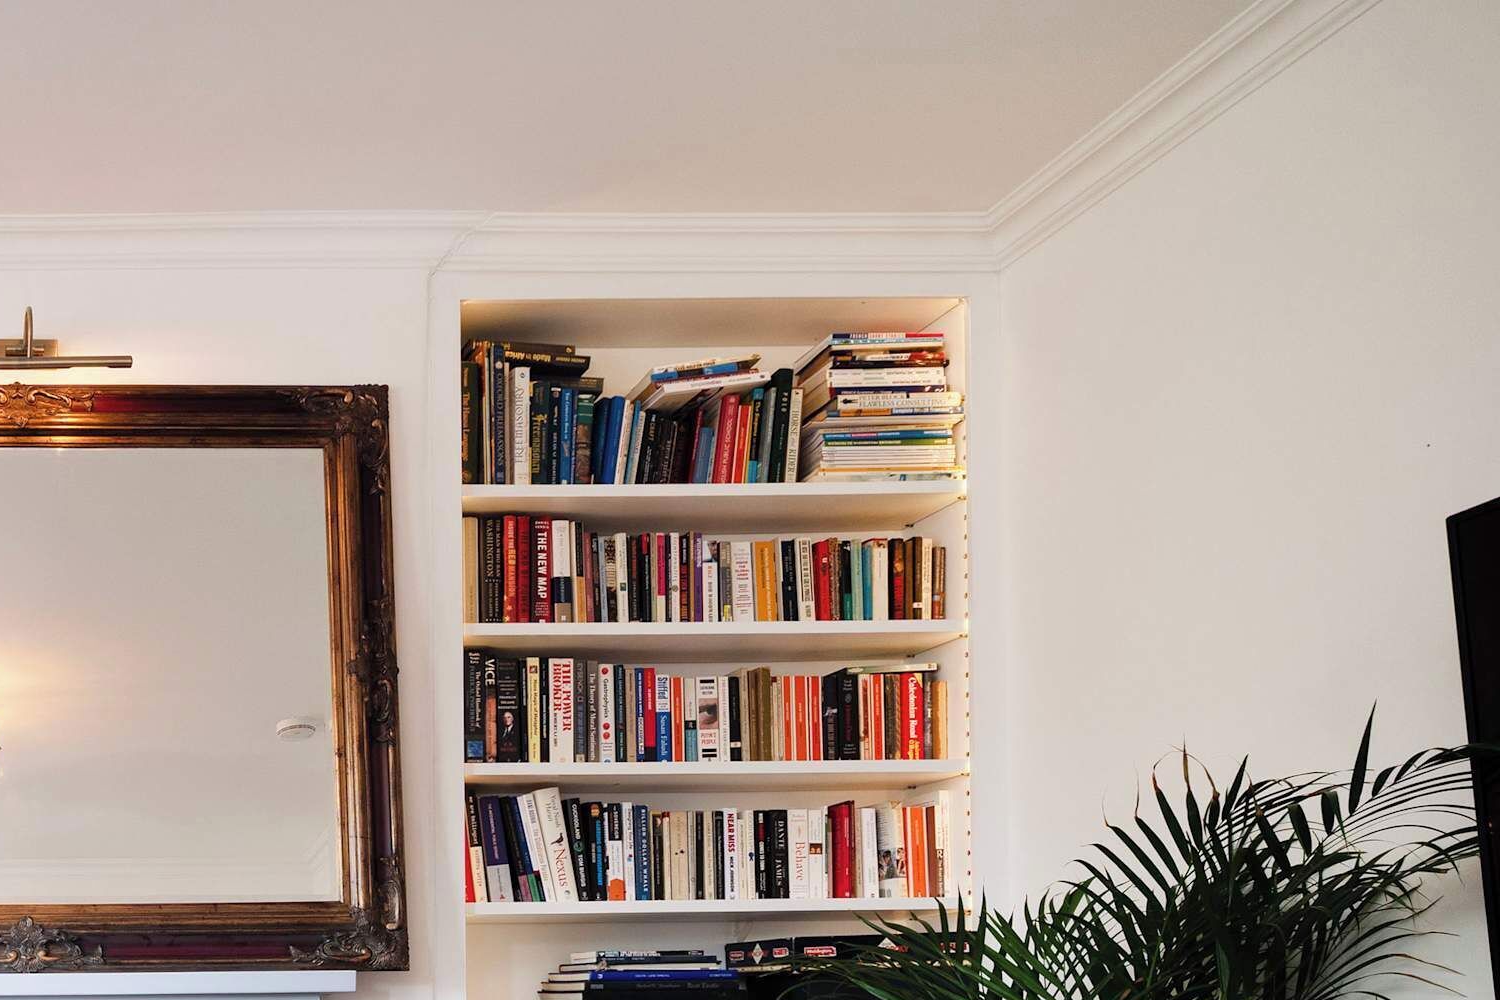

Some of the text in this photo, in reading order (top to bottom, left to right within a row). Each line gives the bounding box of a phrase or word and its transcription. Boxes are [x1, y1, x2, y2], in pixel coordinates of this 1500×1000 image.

[504, 351, 523, 360] Africa
[462, 392, 470, 406] The
[496, 373, 504, 466] OXFORD FREEMASONS
[648, 422, 656, 441] CRAFT
[722, 418, 733, 464] SCHOOL PUBLIC
[787, 411, 800, 473] HORSE RIDER
[486, 520, 494, 578] WASHINGTON
[508, 549, 516, 565] RED
[537, 532, 547, 599] THE NEW MAP
[485, 658, 496, 687] VICE
[553, 663, 562, 711] BROKER
[657, 677, 668, 699] Stiffed
[562, 662, 572, 731] THE POWER
[908, 677, 919, 738] Caledonian Road
[572, 804, 581, 840] CUCKOOLAND
[579, 867, 587, 888] BURGIS
[727, 813, 736, 853] NEAR MISS
[555, 848, 568, 887] Nexus
[775, 859, 783, 886] JAMES
[796, 842, 806, 880] Behave
